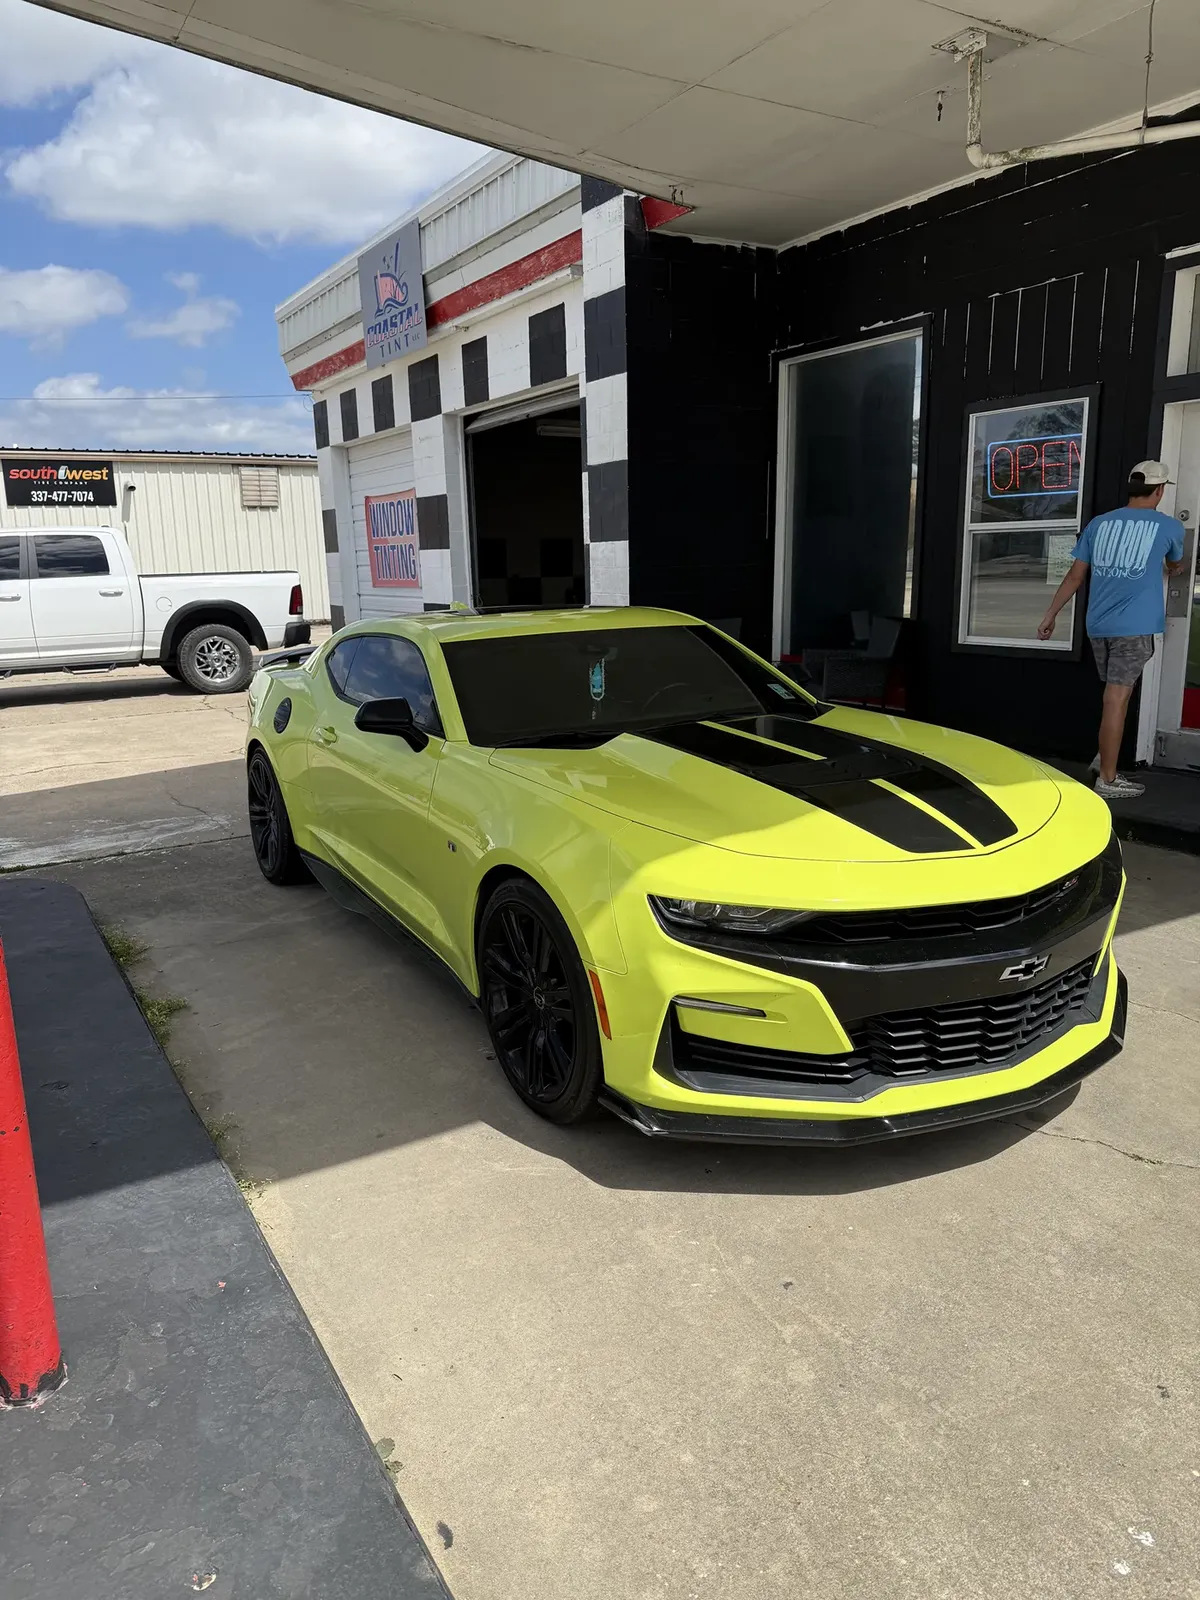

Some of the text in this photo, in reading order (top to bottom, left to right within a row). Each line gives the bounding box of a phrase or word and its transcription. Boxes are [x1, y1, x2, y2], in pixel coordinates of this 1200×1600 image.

[367, 303, 422, 348] COASTAL
[380, 333, 409, 358] TINT
[31, 491, 94, 502] 337-477-7074
[369, 498, 414, 538] WINDOW
[373, 543, 417, 580] TINTING
